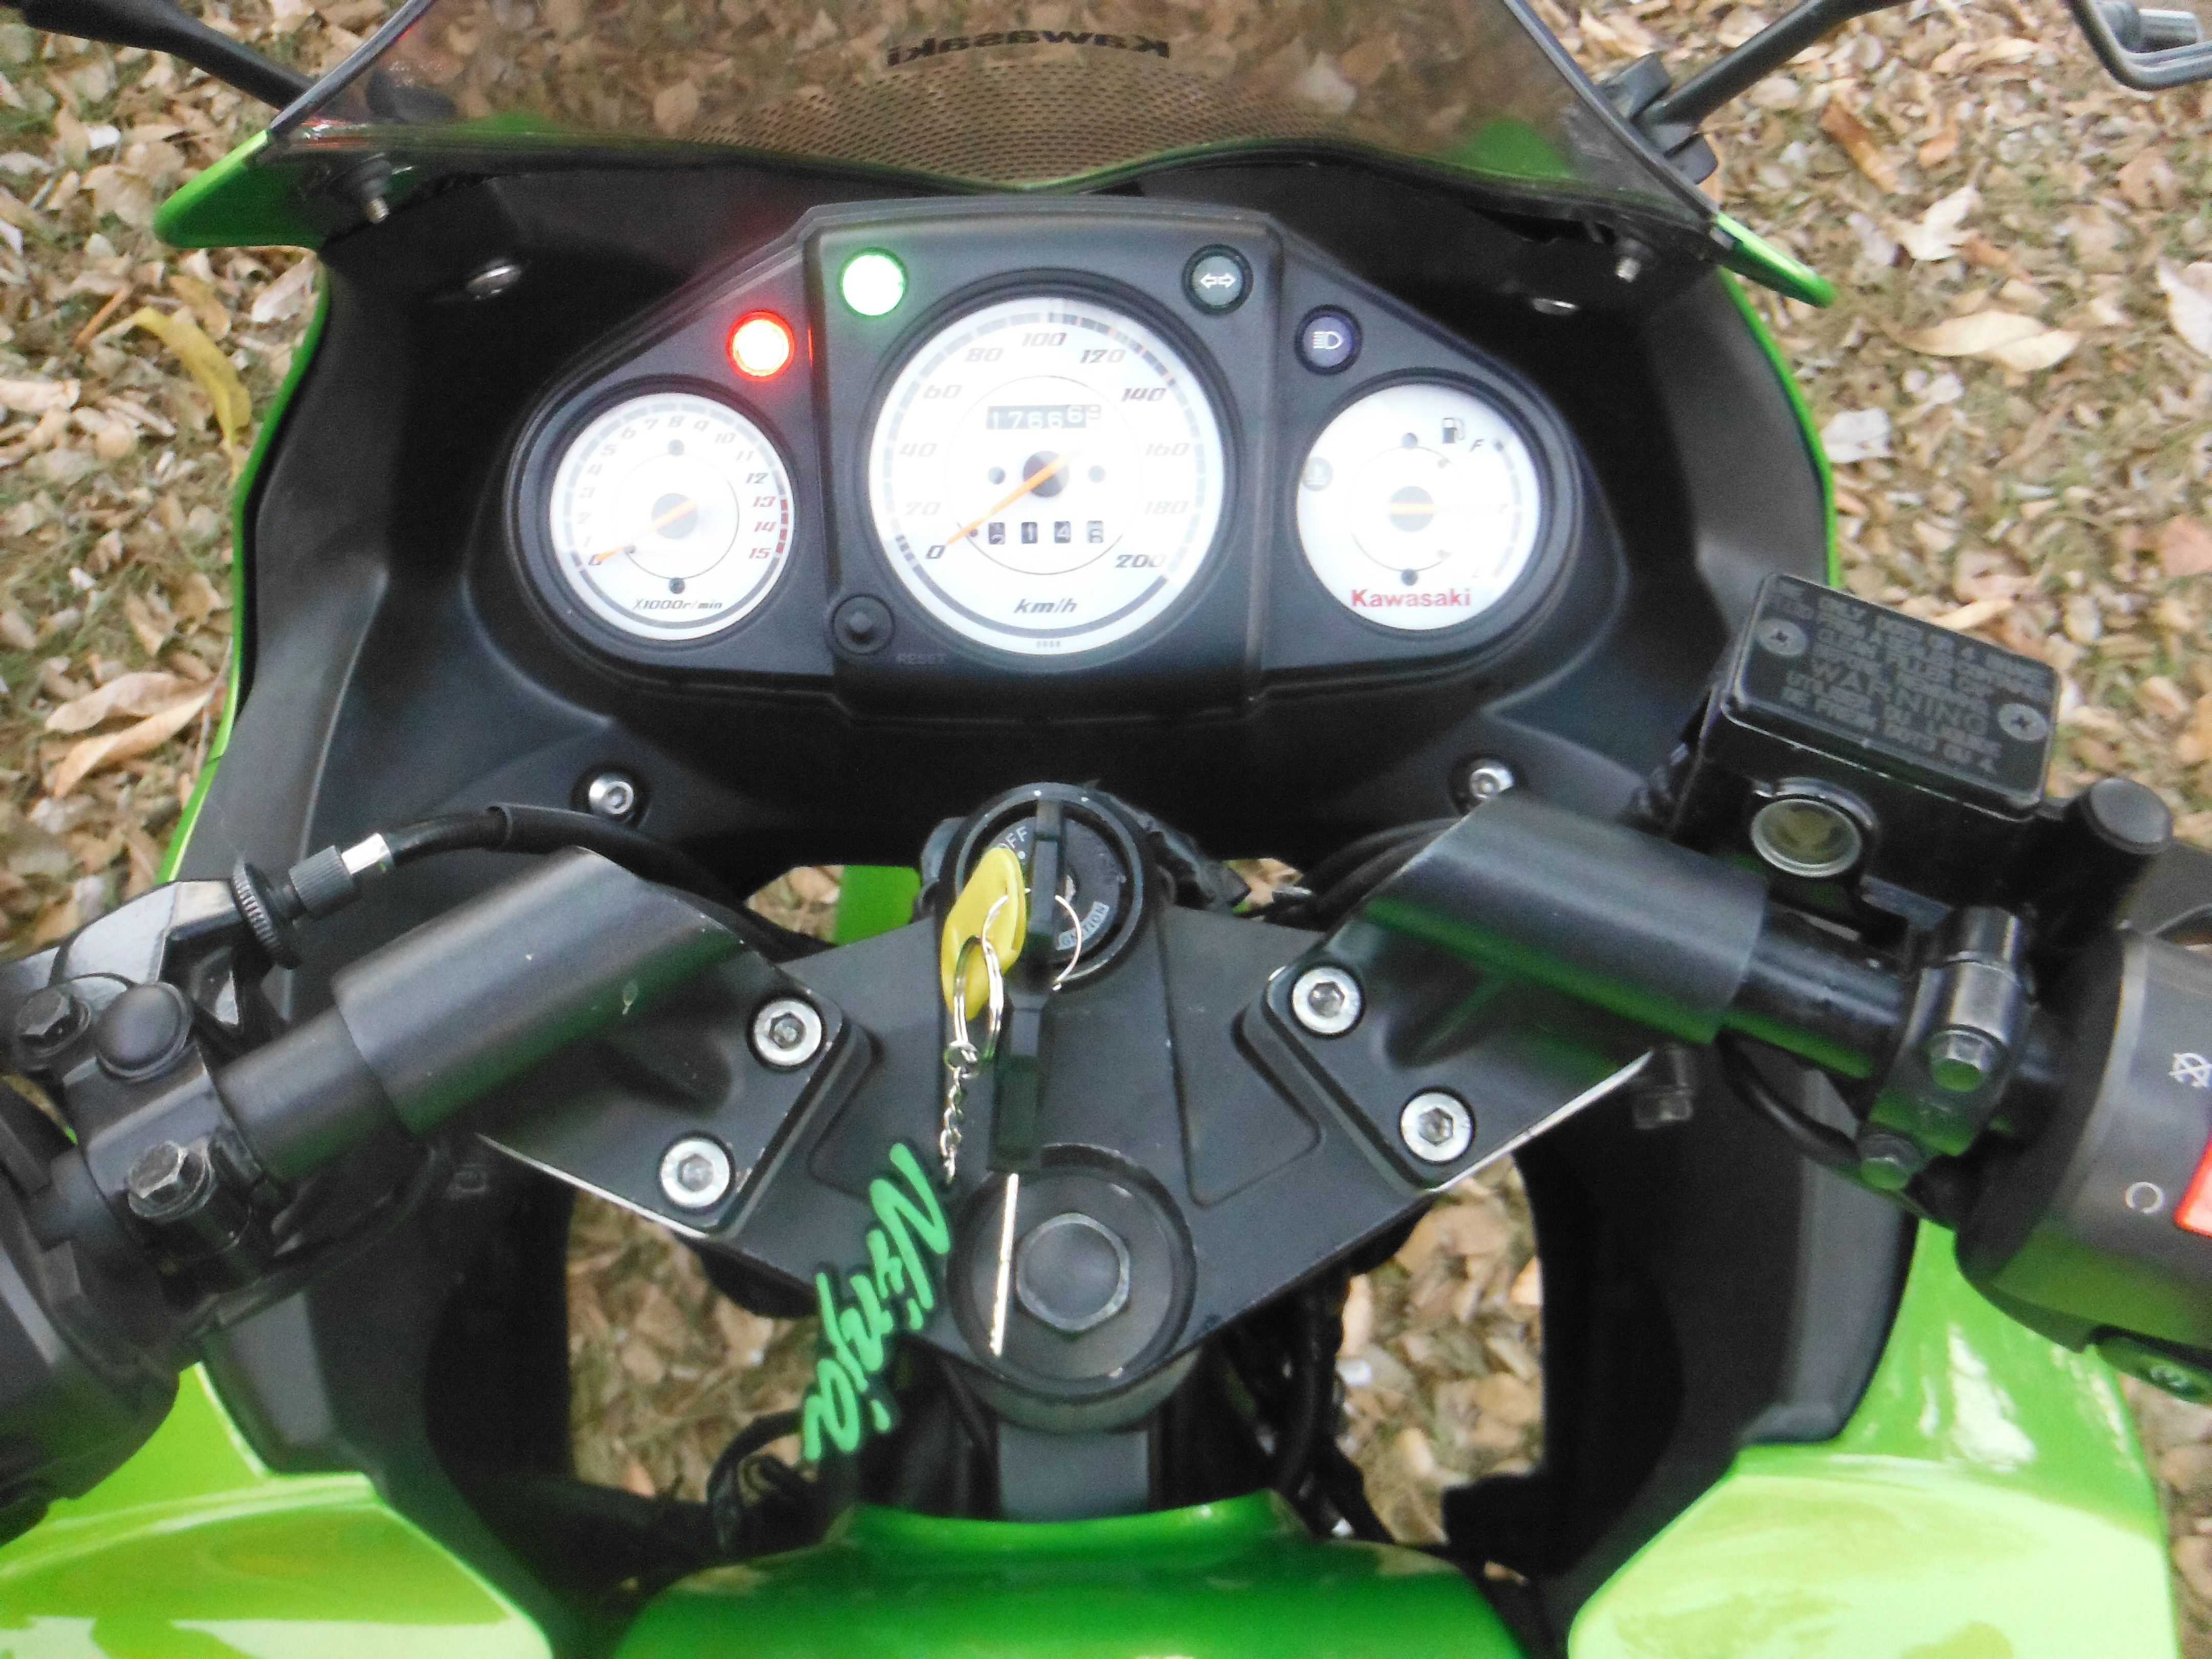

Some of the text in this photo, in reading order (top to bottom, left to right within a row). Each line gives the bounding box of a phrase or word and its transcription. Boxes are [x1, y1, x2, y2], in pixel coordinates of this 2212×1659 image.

[1021, 332, 1068, 347] 100
[965, 348, 1004, 361] 80
[1080, 348, 1126, 364] 120
[923, 385, 962, 399] 60
[1121, 388, 1166, 401] 140
[644, 418, 659, 430] 7
[667, 416, 685, 428] 8
[694, 419, 709, 432] 9
[714, 433, 737, 443] 10
[899, 443, 938, 457] 40
[1145, 443, 1189, 456] 160
[1469, 438, 1485, 452] F
[735, 450, 754, 461] 11
[746, 472, 769, 484] 12
[753, 496, 776, 507] 13
[1144, 501, 1189, 514] 180
[904, 502, 941, 516] 20
[754, 521, 776, 532] 14
[749, 547, 772, 559] 15
[925, 544, 947, 560] 0
[1115, 554, 1166, 568] 200
[1350, 588, 1472, 607] Kawasaki
[1013, 598, 1078, 613] km/h
[1807, 658, 1990, 736] WARNING
[804, 1143, 950, 1461] Ninja
